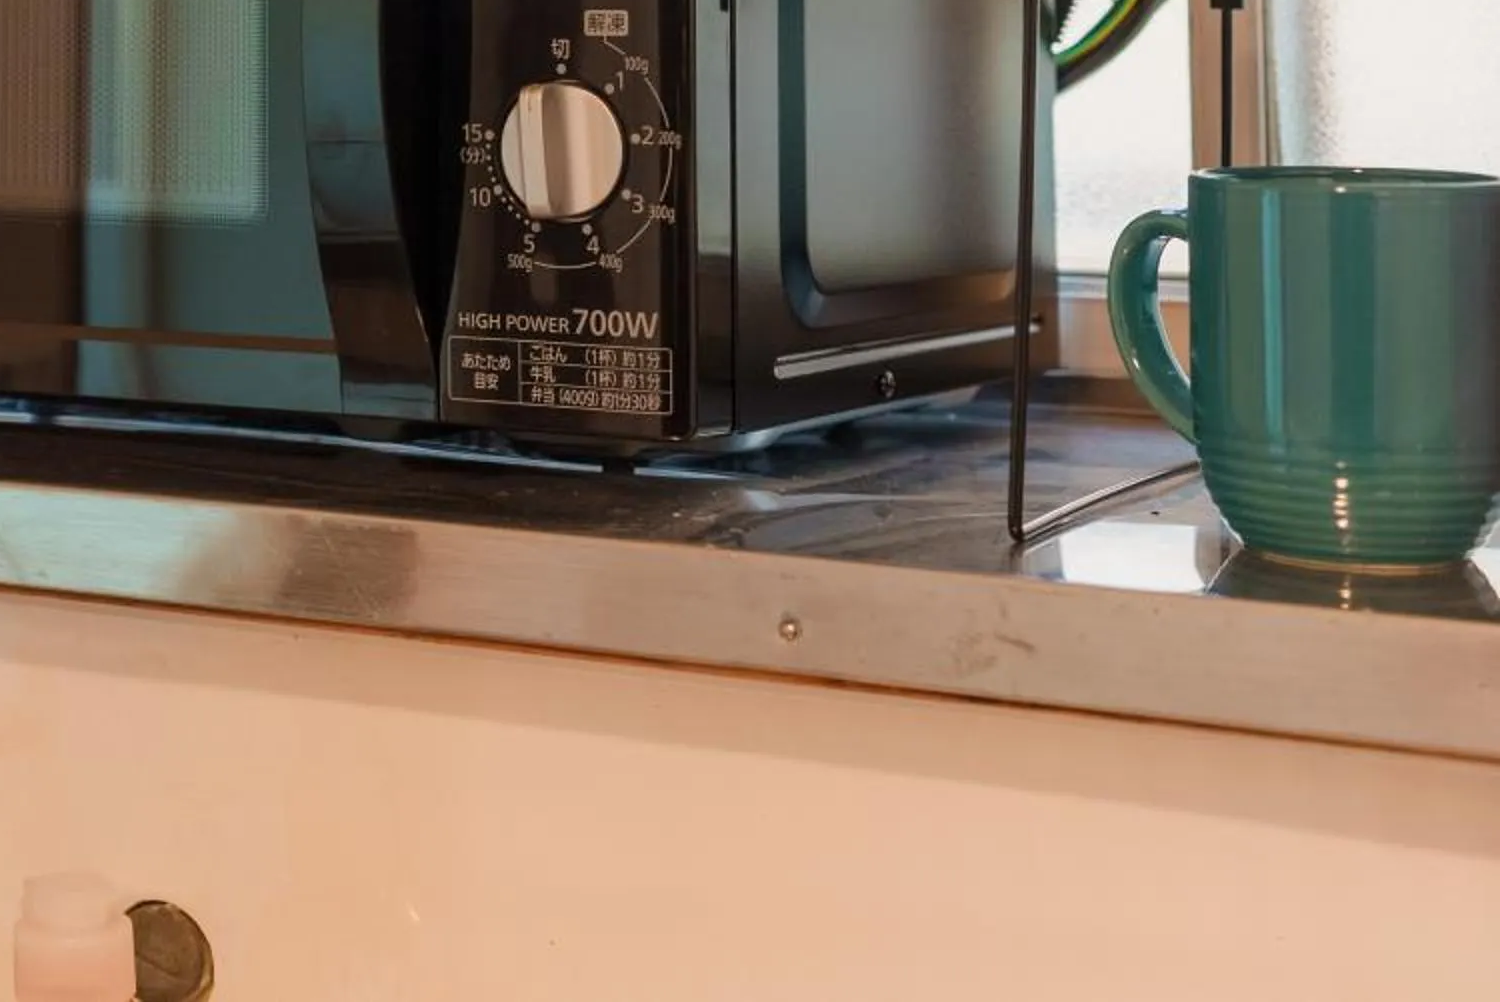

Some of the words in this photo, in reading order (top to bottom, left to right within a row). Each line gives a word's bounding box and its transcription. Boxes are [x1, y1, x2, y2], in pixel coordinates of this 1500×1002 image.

[615, 71, 624, 90] 1
[462, 123, 483, 142] 15
[641, 127, 653, 145] 2
[470, 187, 491, 207] 10
[631, 196, 643, 214] 3
[523, 234, 536, 254] 5
[586, 235, 600, 255] 4
[458, 312, 501, 330] HIGH
[505, 314, 570, 335] POWER
[572, 308, 659, 339] 700W
